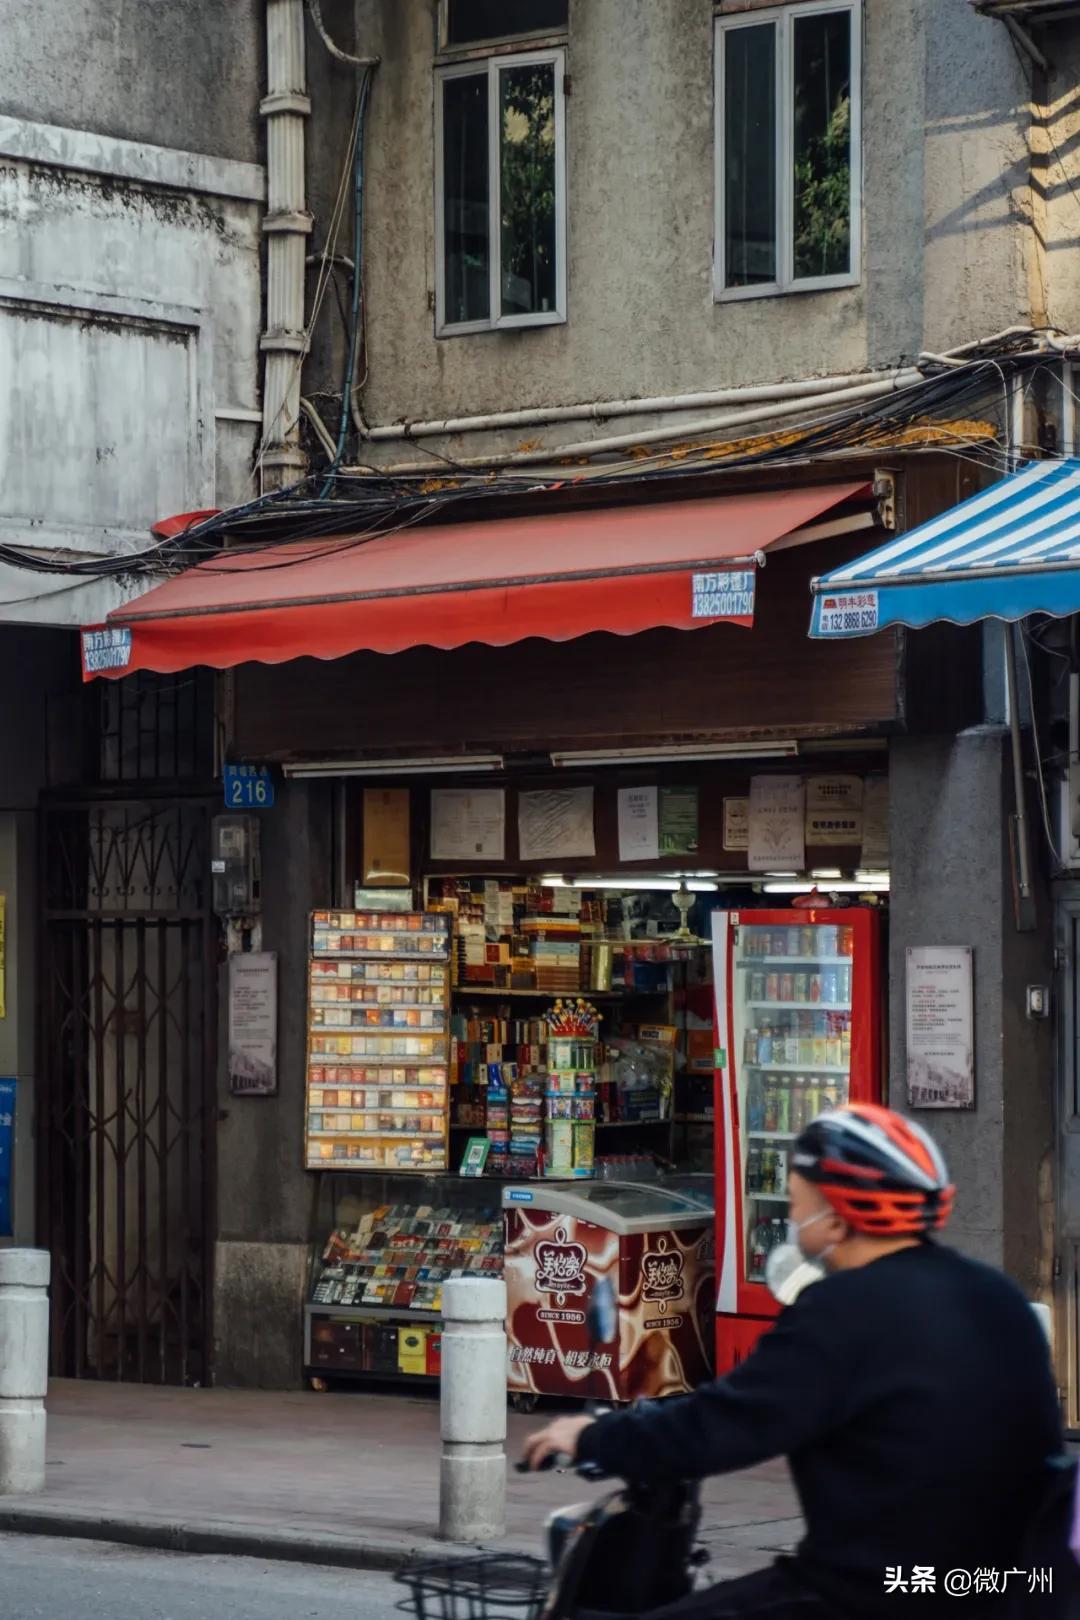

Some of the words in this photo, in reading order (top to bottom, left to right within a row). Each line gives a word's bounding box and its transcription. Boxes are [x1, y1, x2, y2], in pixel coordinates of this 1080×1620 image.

[693, 592, 754, 616] 13825001790
[830, 613, 842, 630] 132
[232, 780, 266, 803] 216
[561, 1312, 582, 1322] 1956
